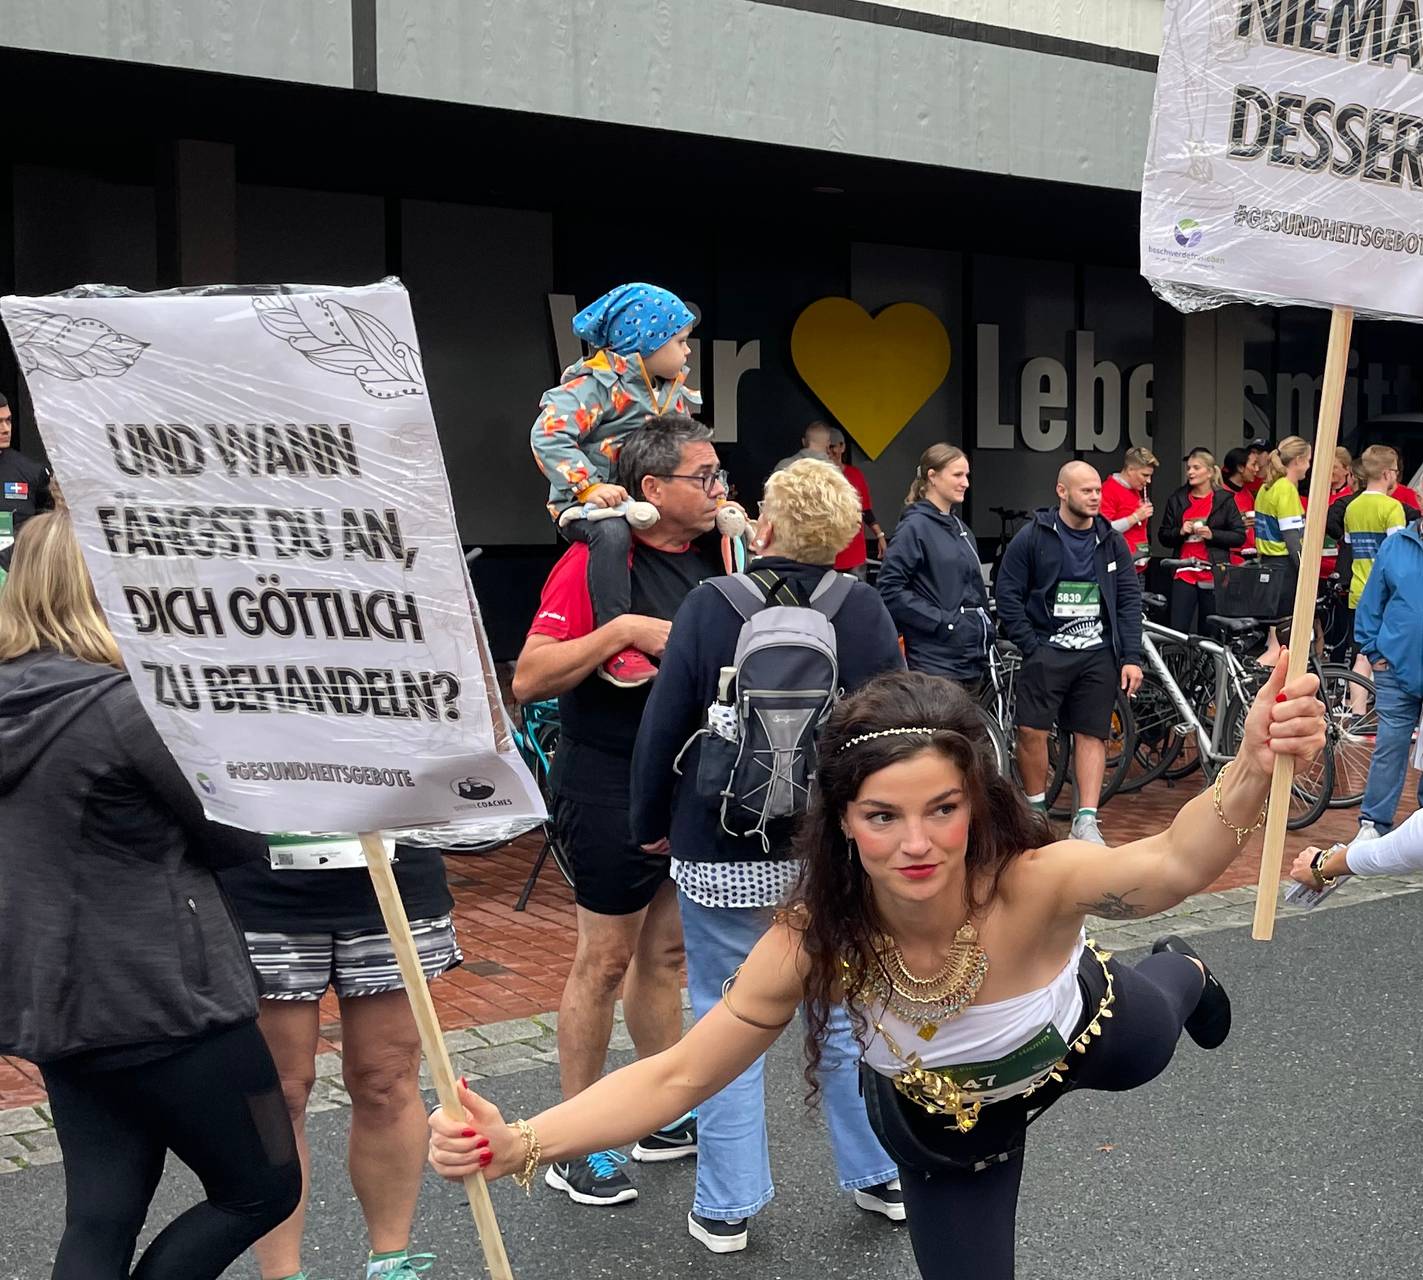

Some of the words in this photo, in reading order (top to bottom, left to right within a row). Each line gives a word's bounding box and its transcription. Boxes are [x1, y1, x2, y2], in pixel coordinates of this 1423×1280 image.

[105, 423, 203, 479] UND
[208, 423, 362, 479] WANN
[95, 491, 262, 561] FÄNGST
[271, 506, 329, 561] DU
[338, 507, 418, 571] AN,
[122, 585, 226, 638] DICH
[230, 573, 426, 643] GÖTTLICH
[1057, 593, 1082, 603] 5839
[141, 661, 202, 711] ZU
[203, 663, 463, 722] BEHANDELN?
[226, 760, 415, 788] #GESUNDHEITSGEBOTE
